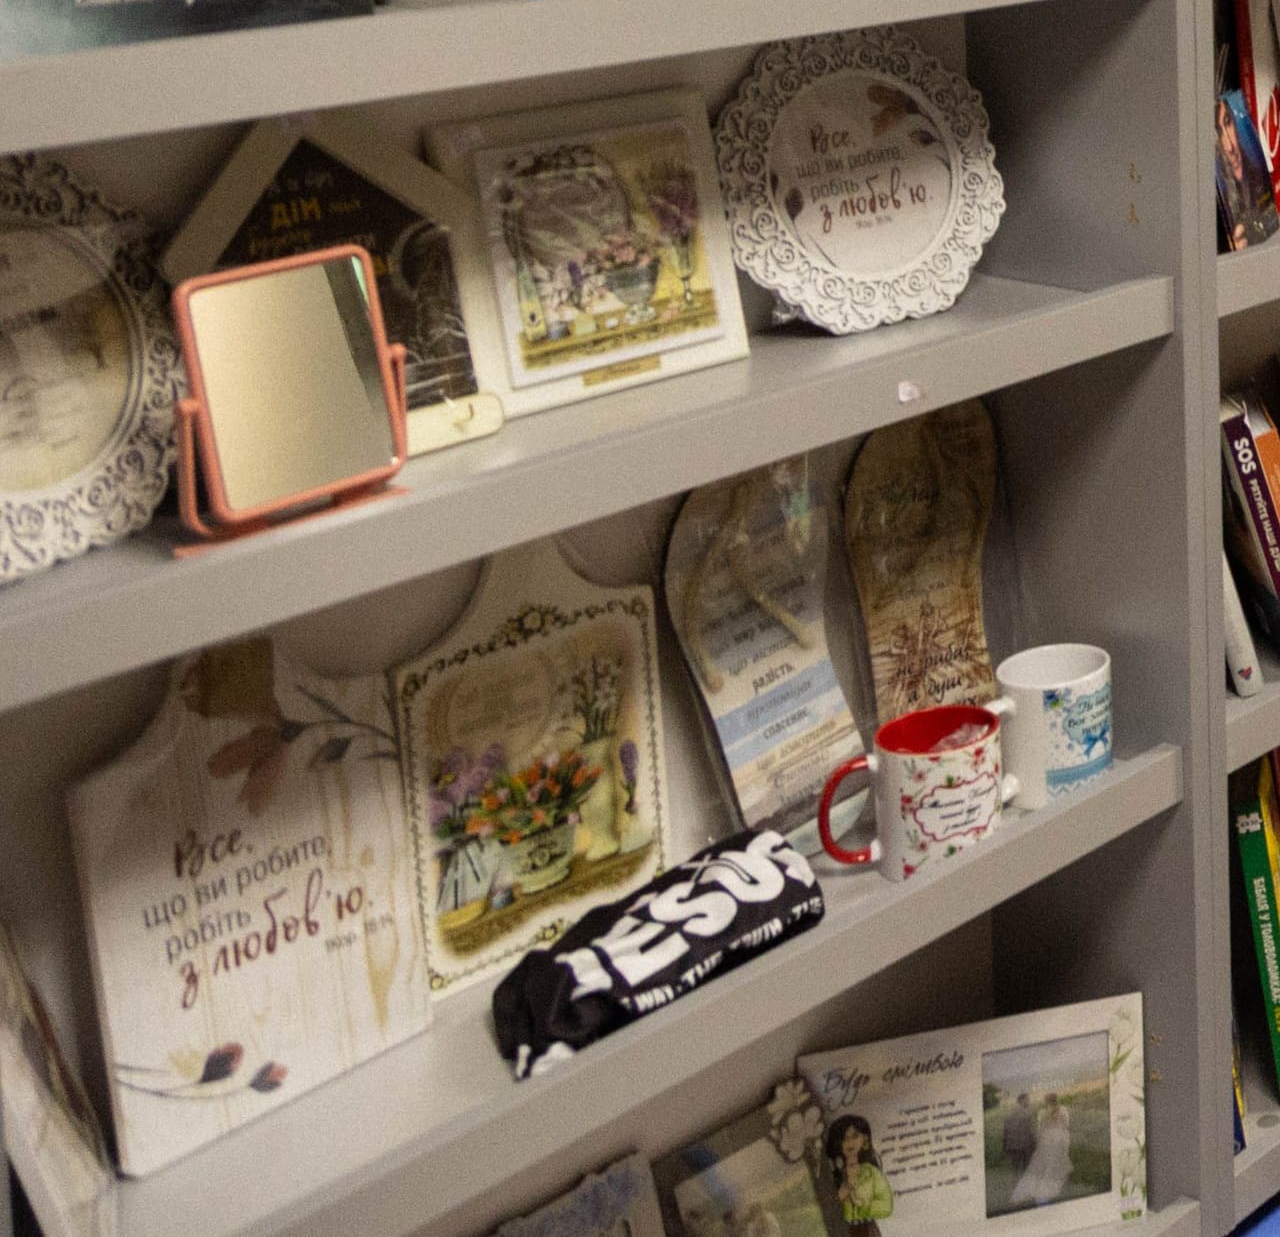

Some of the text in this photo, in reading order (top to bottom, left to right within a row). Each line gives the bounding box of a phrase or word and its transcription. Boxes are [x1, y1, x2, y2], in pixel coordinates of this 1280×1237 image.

[1234, 437, 1257, 475] SOS
[142, 893, 188, 931] що
[554, 829, 817, 1001] JESUS
